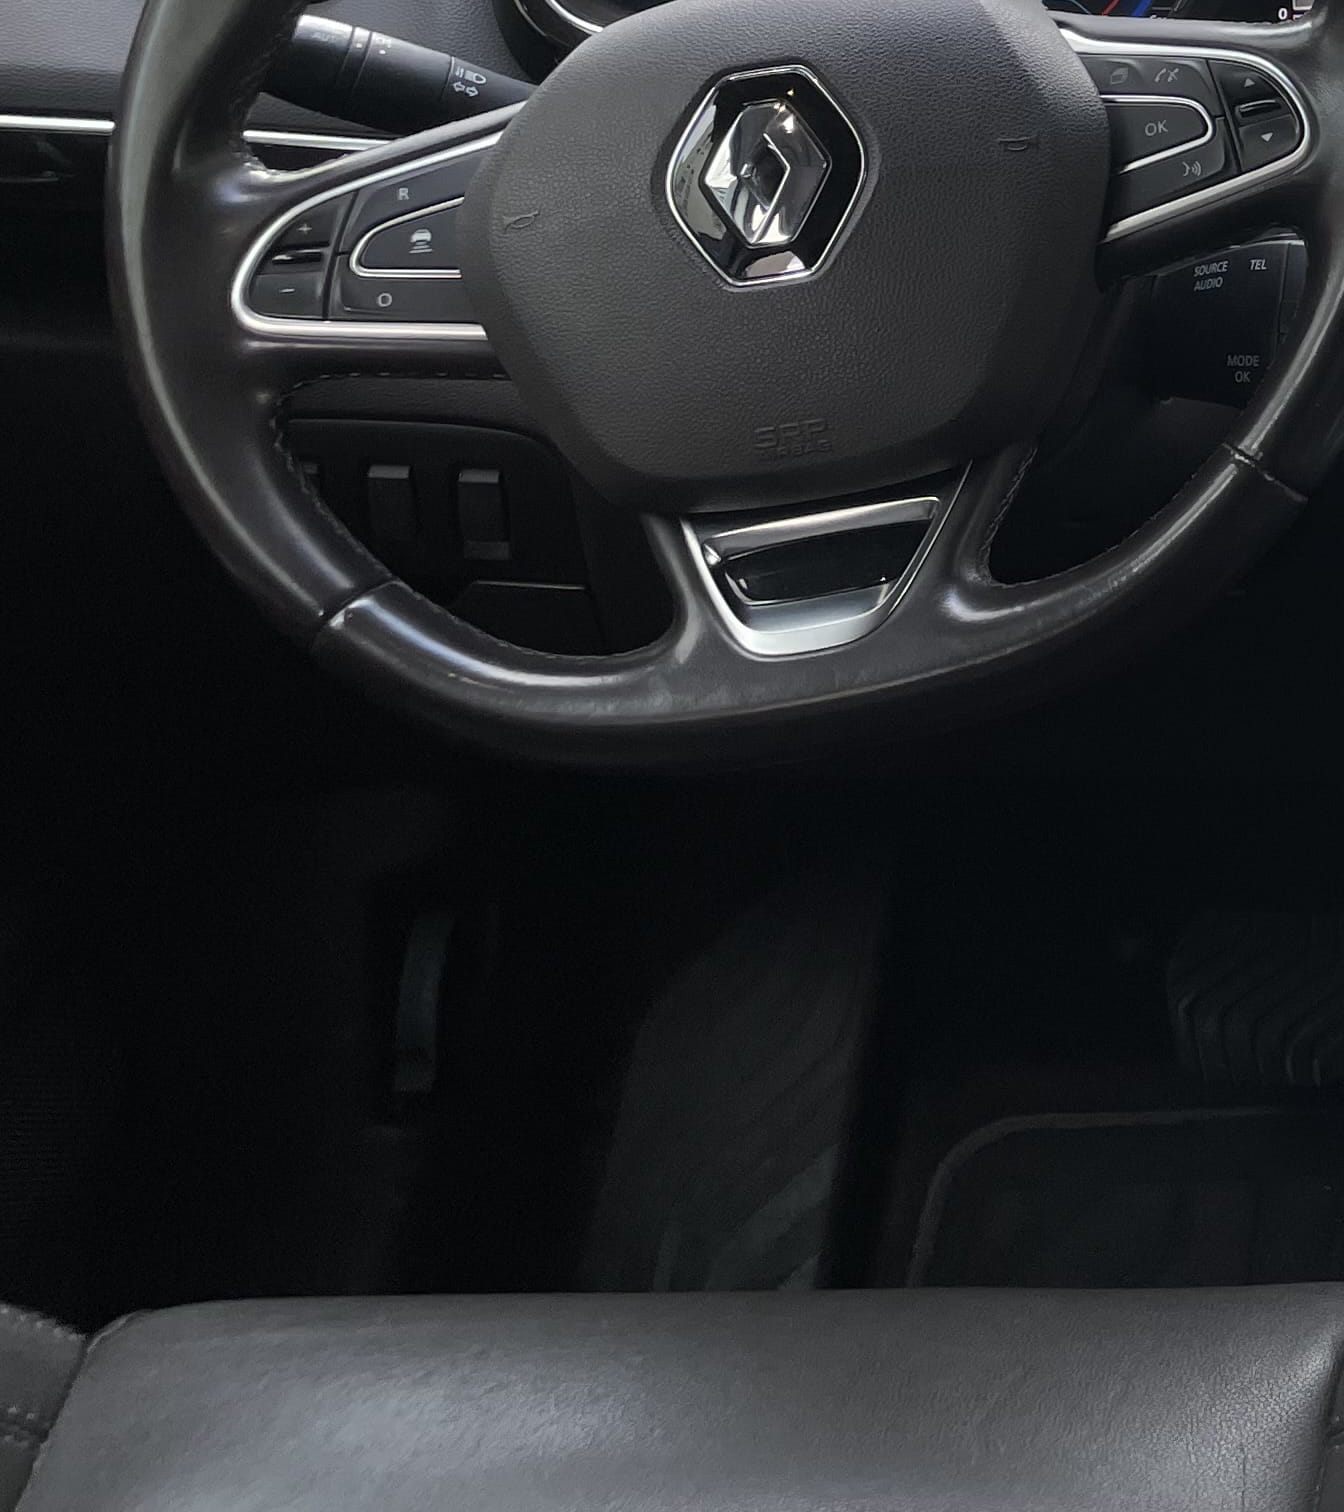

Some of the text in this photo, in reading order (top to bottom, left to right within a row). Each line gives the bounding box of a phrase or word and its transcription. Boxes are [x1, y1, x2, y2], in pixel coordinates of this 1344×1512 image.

[1144, 119, 1168, 137] OK
[397, 187, 411, 201] R
[1193, 259, 1229, 278] SOURCE
[1249, 258, 1268, 272] TEL
[1193, 275, 1224, 292] AUDIO
[1226, 354, 1260, 369] MODE
[1234, 370, 1251, 384] OK
